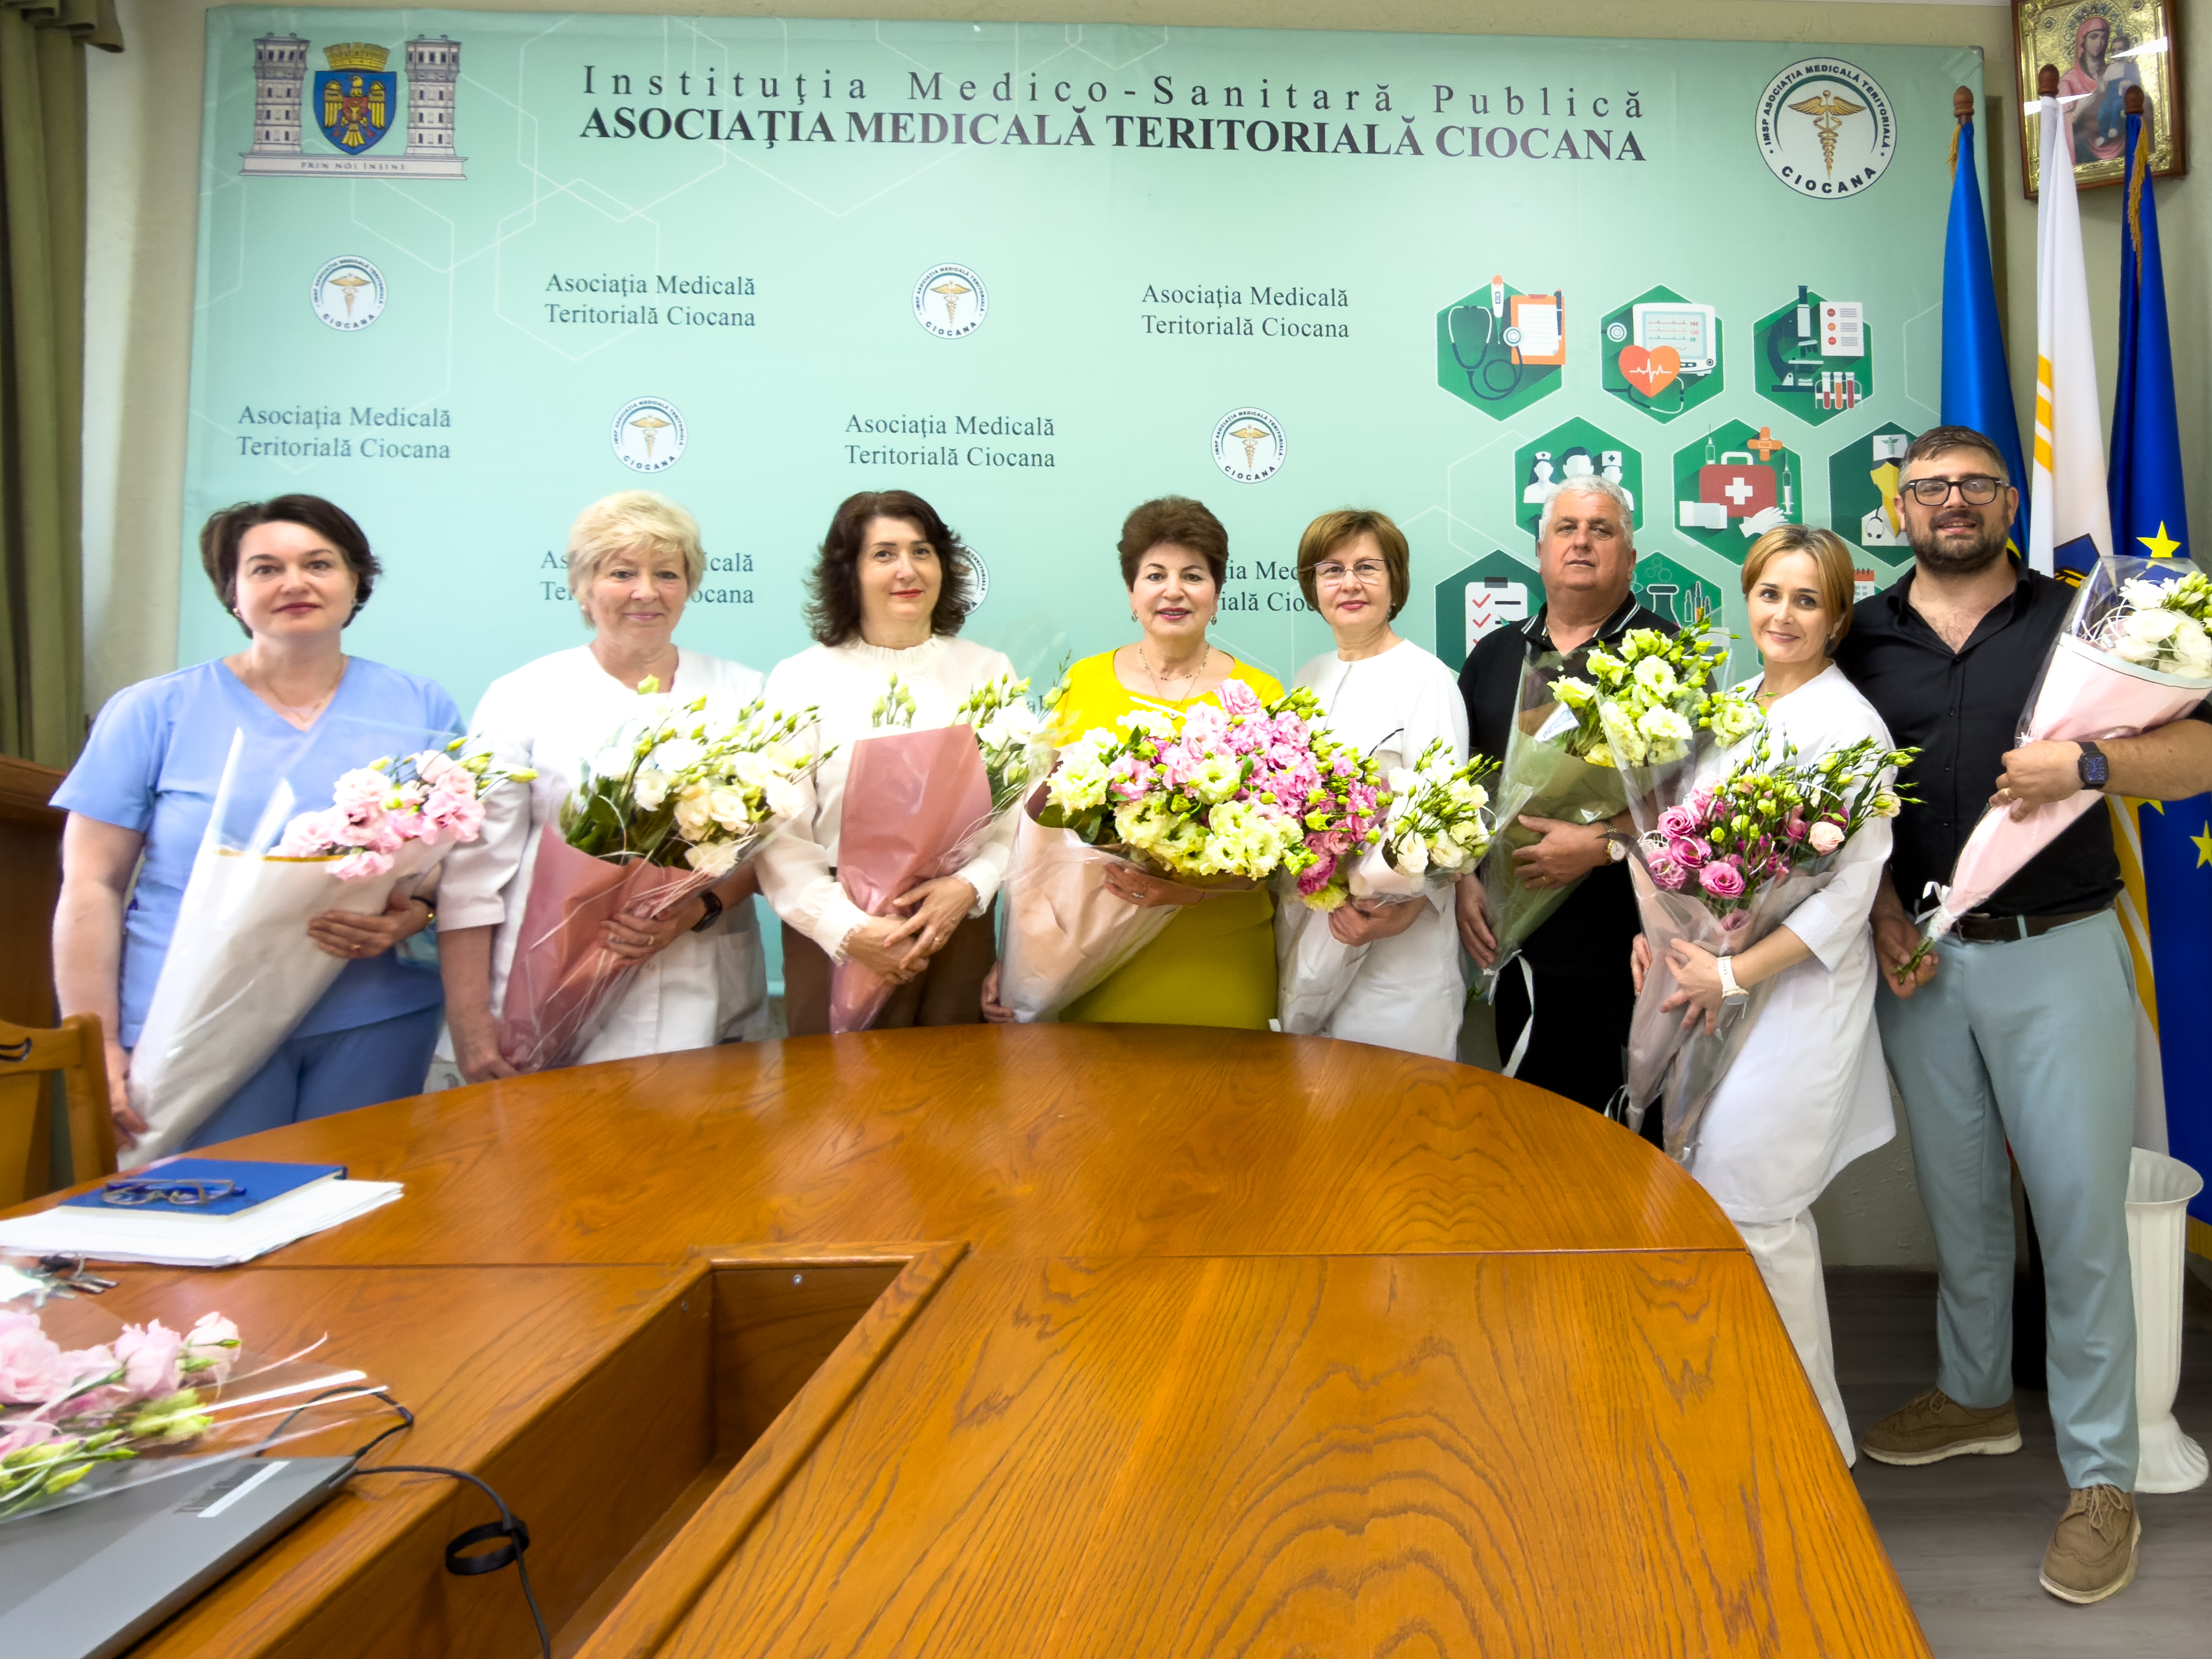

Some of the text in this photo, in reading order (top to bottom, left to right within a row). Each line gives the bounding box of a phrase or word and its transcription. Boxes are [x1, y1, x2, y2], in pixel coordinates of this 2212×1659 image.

[1432, 84, 1643, 118] Publică
[845, 105, 1096, 146] MEDICALĂ
[1106, 115, 1425, 156] TERITORIALĂ
[1435, 125, 1647, 161] CIOCANA
[1761, 119, 1771, 146] IMSP
[1781, 166, 1877, 194] CIOCANA
[656, 275, 755, 295] Medicală
[1250, 286, 1349, 307] Medicală
[323, 313, 375, 329] CIOCANA
[544, 304, 755, 326] Teritorială Ciocana
[926, 321, 976, 336] CIOCANA
[1141, 315, 1349, 338] Teritorială Ciocana
[350, 406, 451, 428] Medicală
[955, 415, 1054, 436] Medicală
[236, 436, 450, 459] Teritorială Ciocana
[845, 445, 1055, 467] Teritorială Ciocana
[624, 455, 675, 470] CIOCANA
[1225, 466, 1275, 480] CIOCANA
[691, 589, 755, 603] ocana
